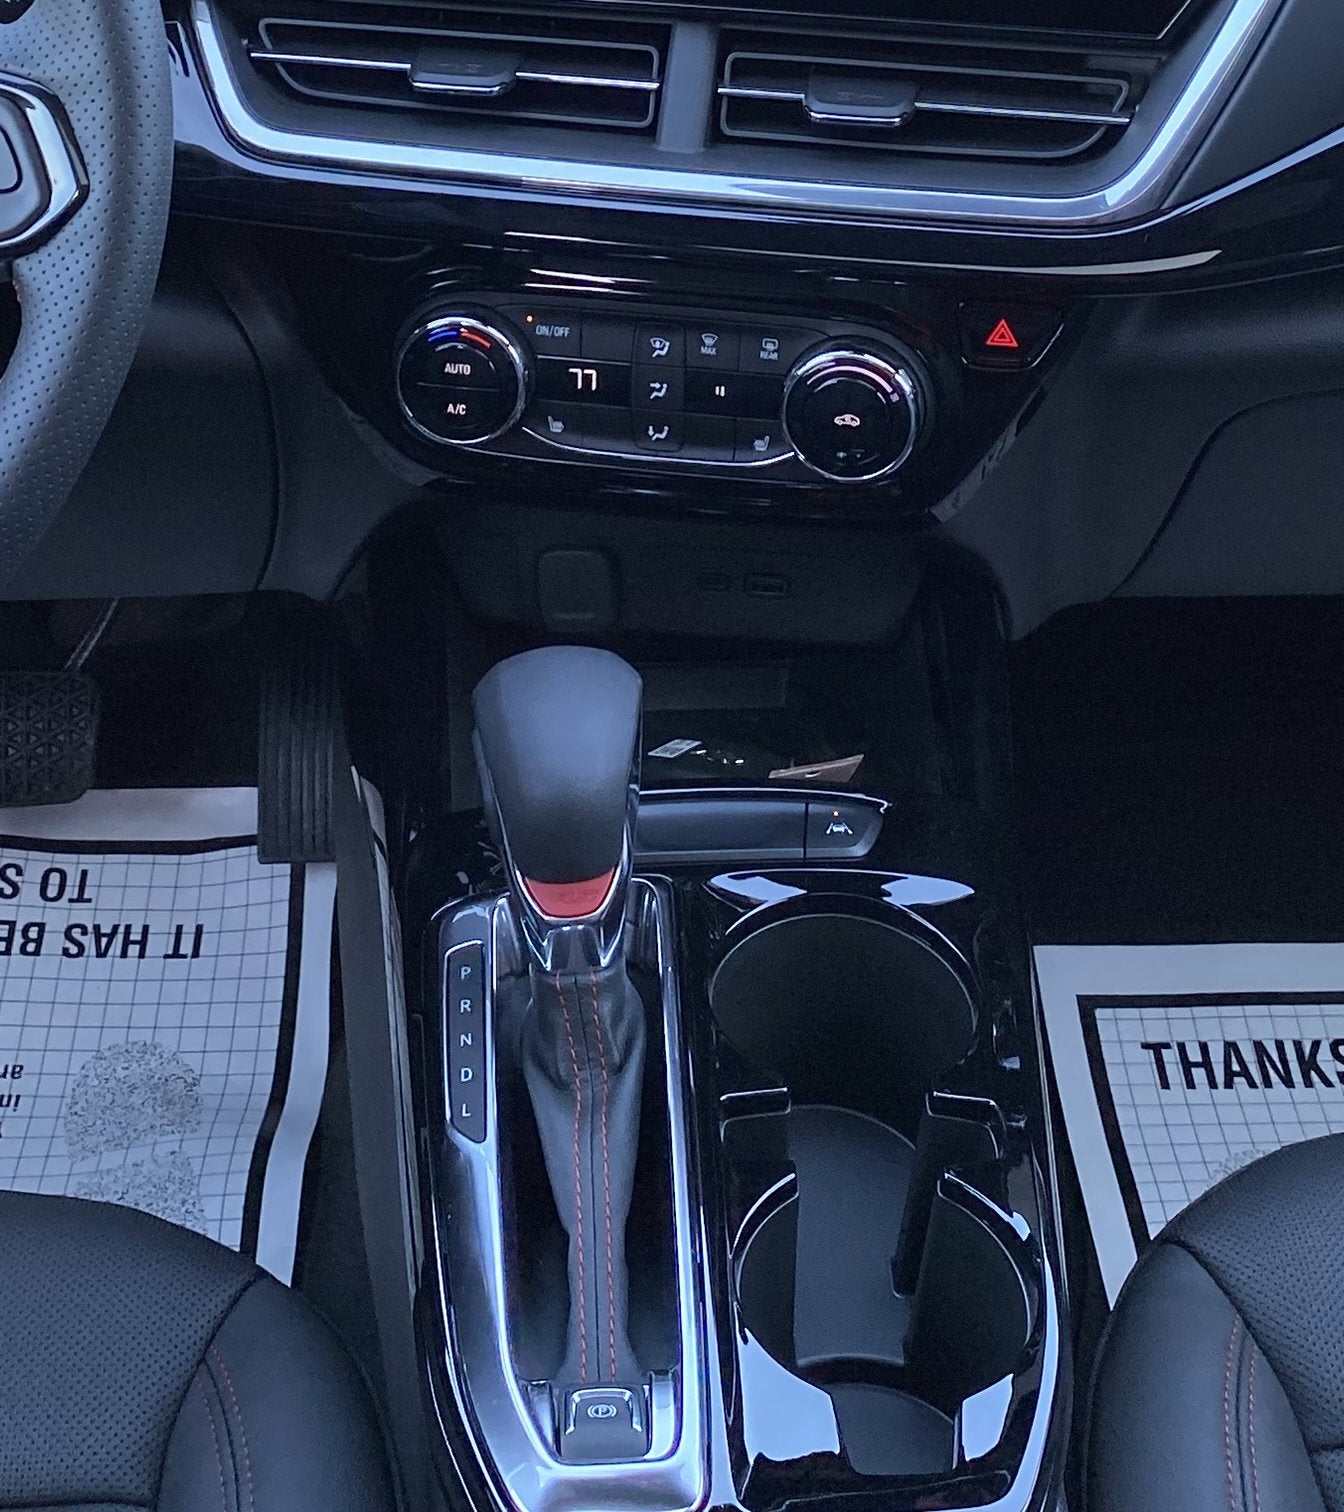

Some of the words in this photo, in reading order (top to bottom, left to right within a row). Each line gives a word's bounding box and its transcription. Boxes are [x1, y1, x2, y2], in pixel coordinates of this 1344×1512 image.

[535, 325, 570, 338] ON/OFF
[700, 346, 717, 356] MAX
[759, 351, 778, 360] REAR
[444, 363, 471, 375] AUTO
[568, 368, 597, 390] 77
[447, 403, 467, 415] A/C
[39, 867, 93, 903] TO
[60, 922, 148, 960] HAS
[163, 923, 204, 959] IT
[460, 967, 471, 980] P
[460, 999, 472, 1013] R
[460, 1033, 472, 1047] N
[461, 1068, 473, 1082] D
[462, 1104, 471, 1117] L
